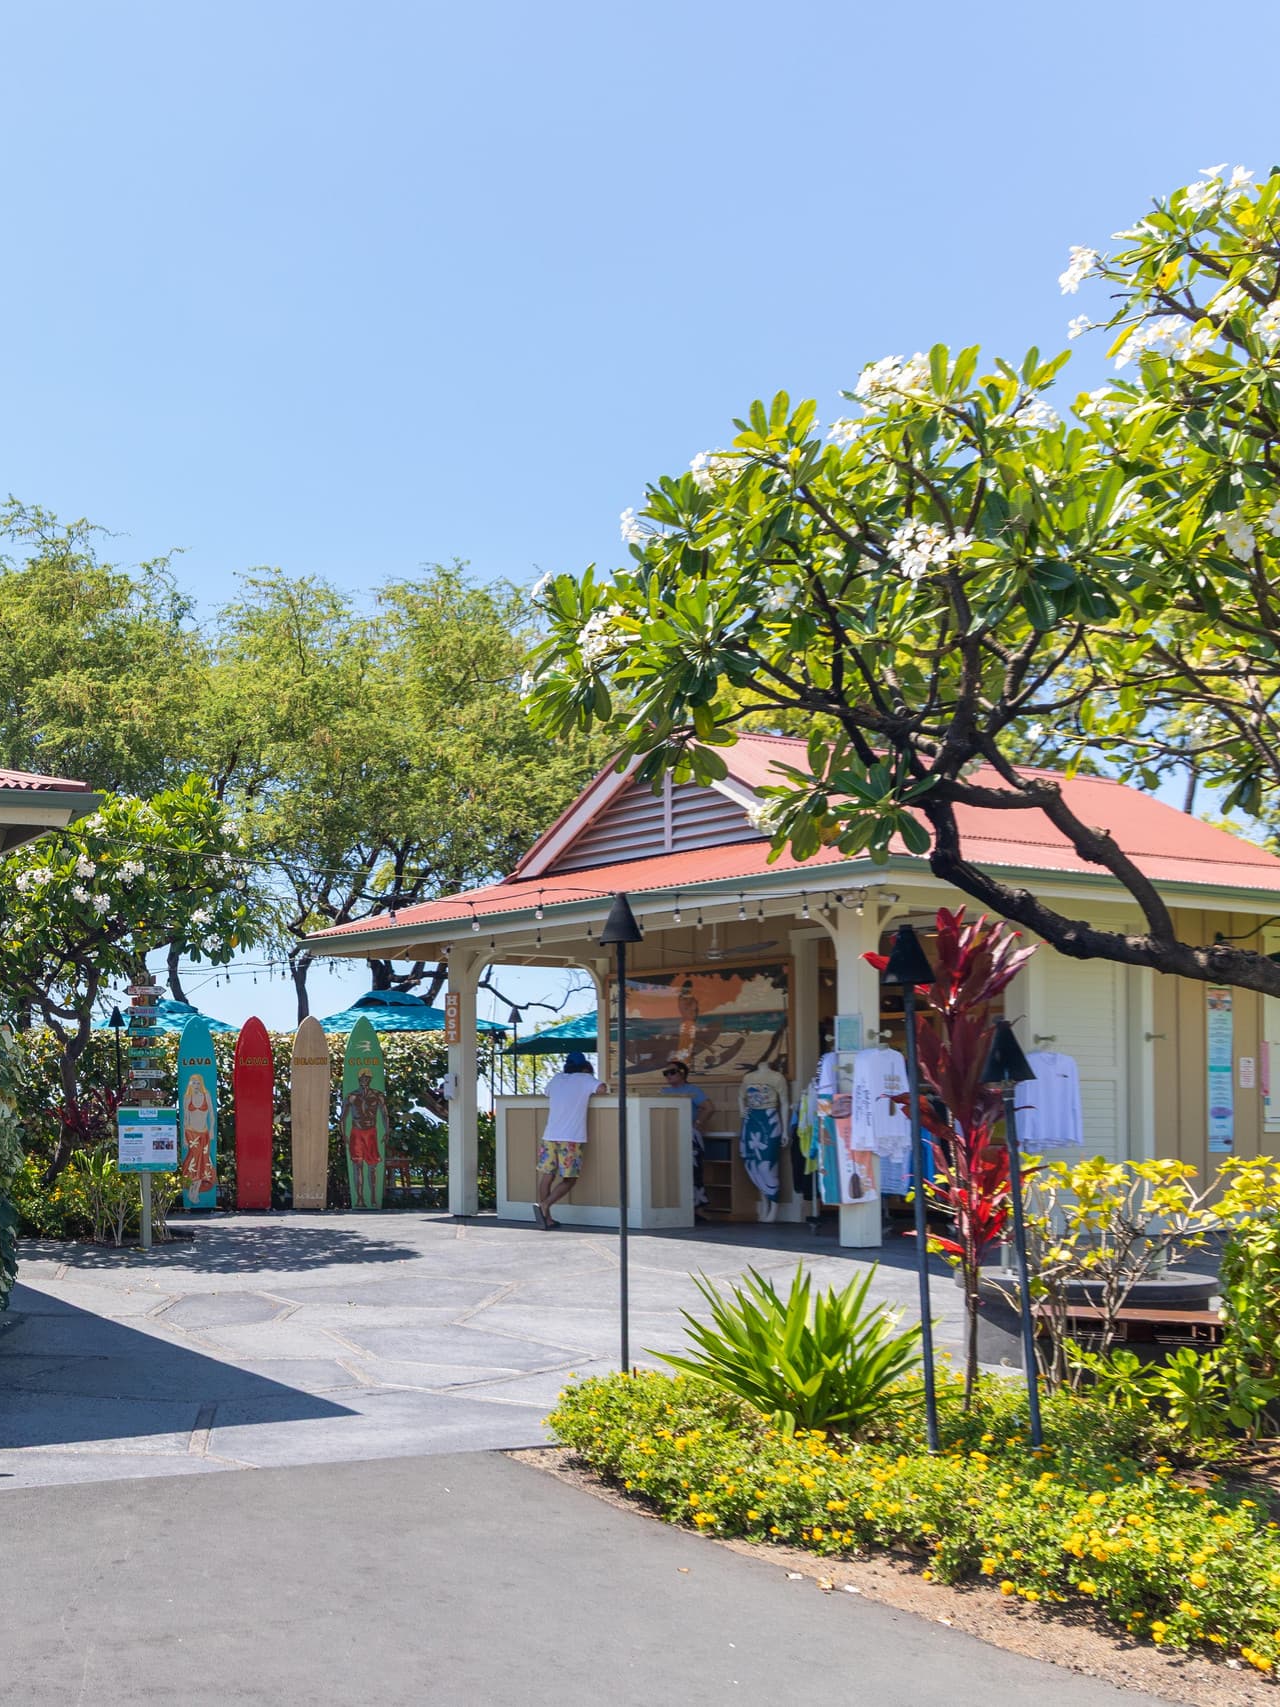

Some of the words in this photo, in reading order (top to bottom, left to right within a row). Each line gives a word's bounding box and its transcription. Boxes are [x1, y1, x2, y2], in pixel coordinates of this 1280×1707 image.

[447, 995, 457, 1041] HOST
[182, 1057, 211, 1066] LAVA
[239, 1057, 269, 1066] LAVA
[293, 1056, 328, 1066] BEACH
[348, 1056, 379, 1066] CLUB
